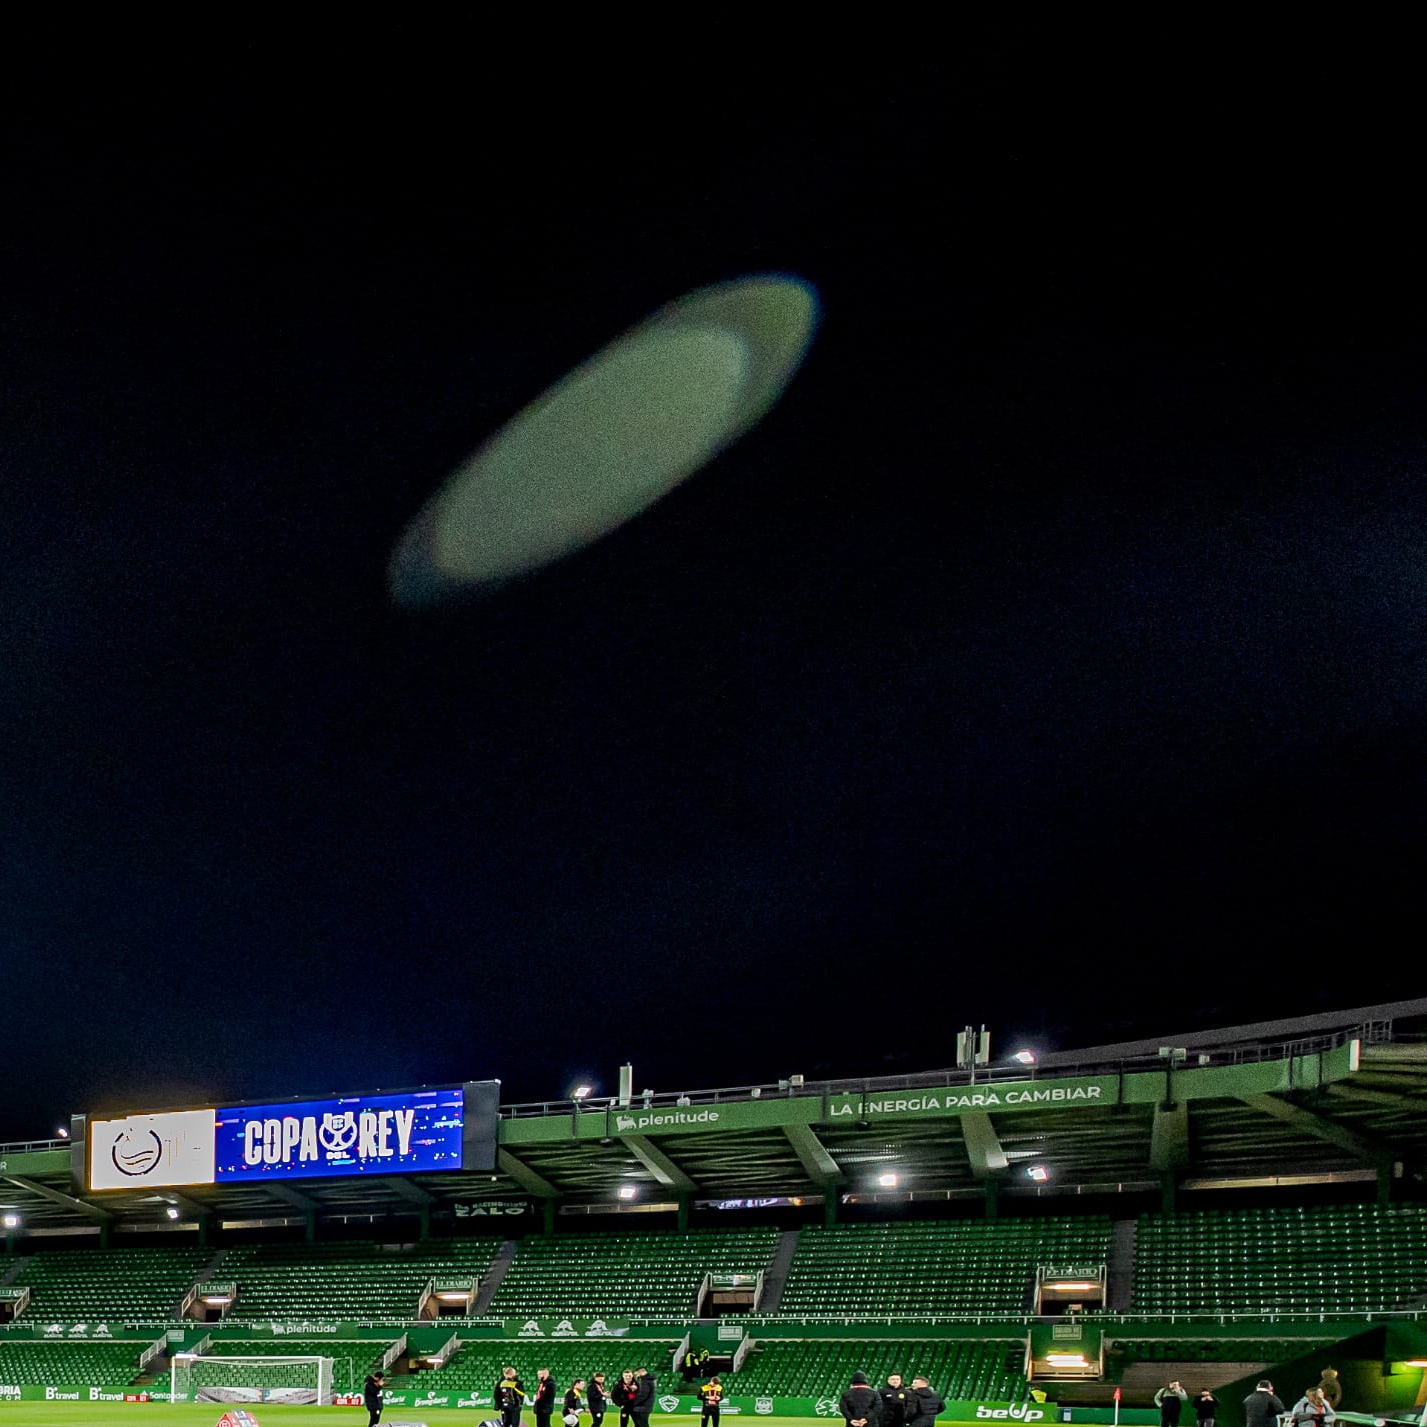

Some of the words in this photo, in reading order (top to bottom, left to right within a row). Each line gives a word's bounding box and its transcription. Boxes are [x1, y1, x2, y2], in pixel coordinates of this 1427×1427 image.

[830, 1103, 853, 1116] LA
[858, 1096, 941, 1114] ENERGÍA
[945, 1093, 1001, 1108] PARA
[1005, 1086, 1101, 1104] CAMBIAR
[639, 1110, 719, 1129] plenitude
[245, 1116, 319, 1165] COPA
[359, 1109, 415, 1157] REY
[286, 1324, 337, 1334] plenitude
[56, 1391, 80, 1400] travel
[99, 1391, 124, 1401] travel
